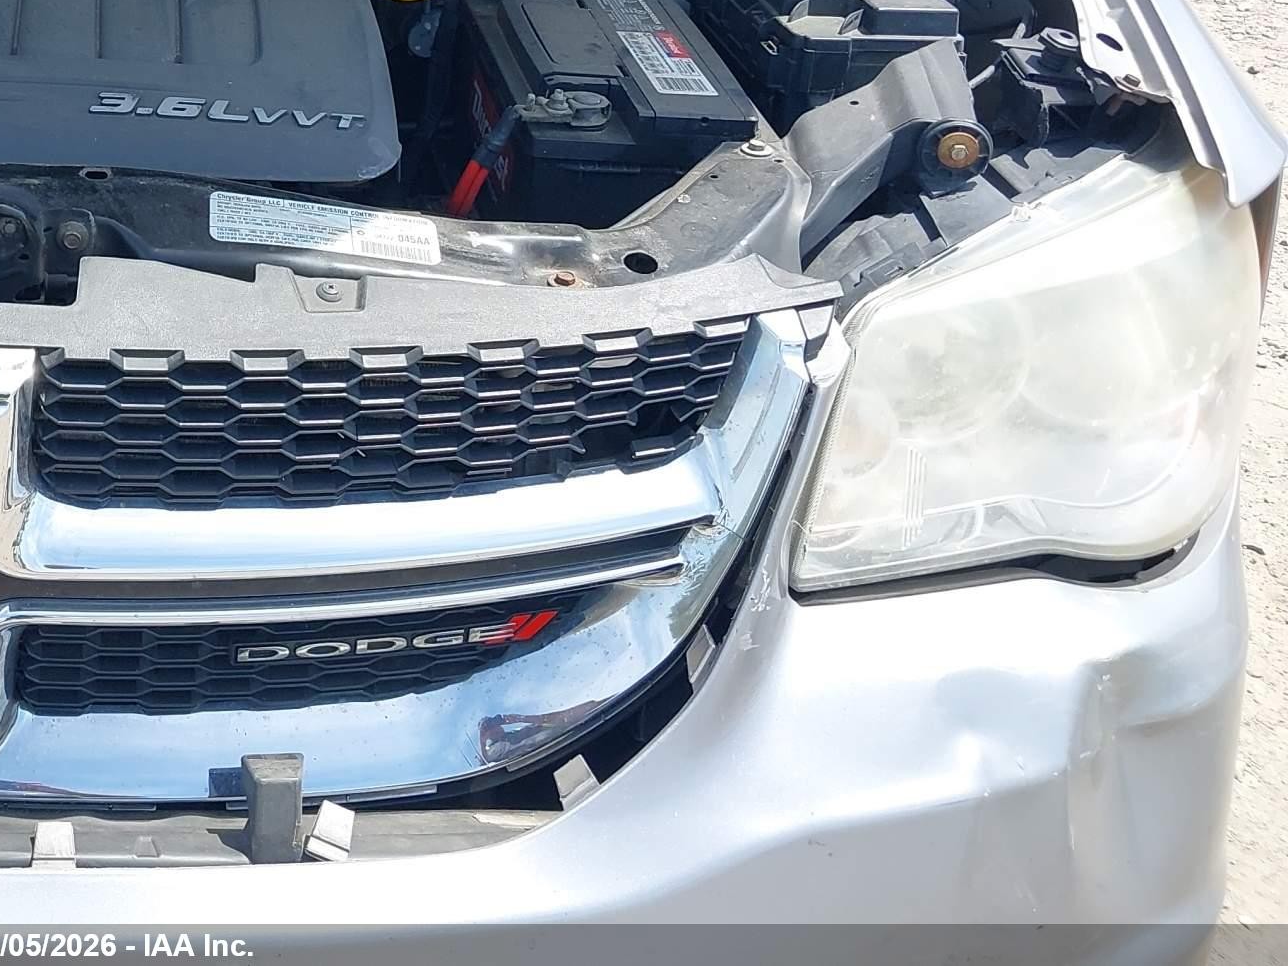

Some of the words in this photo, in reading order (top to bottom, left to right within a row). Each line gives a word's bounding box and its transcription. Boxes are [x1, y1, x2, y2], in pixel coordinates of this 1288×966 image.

[217, 193, 244, 201] Chrysler
[246, 197, 266, 205] Group
[288, 202, 315, 210] VEHICLE
[237, 622, 516, 663] DODGE
